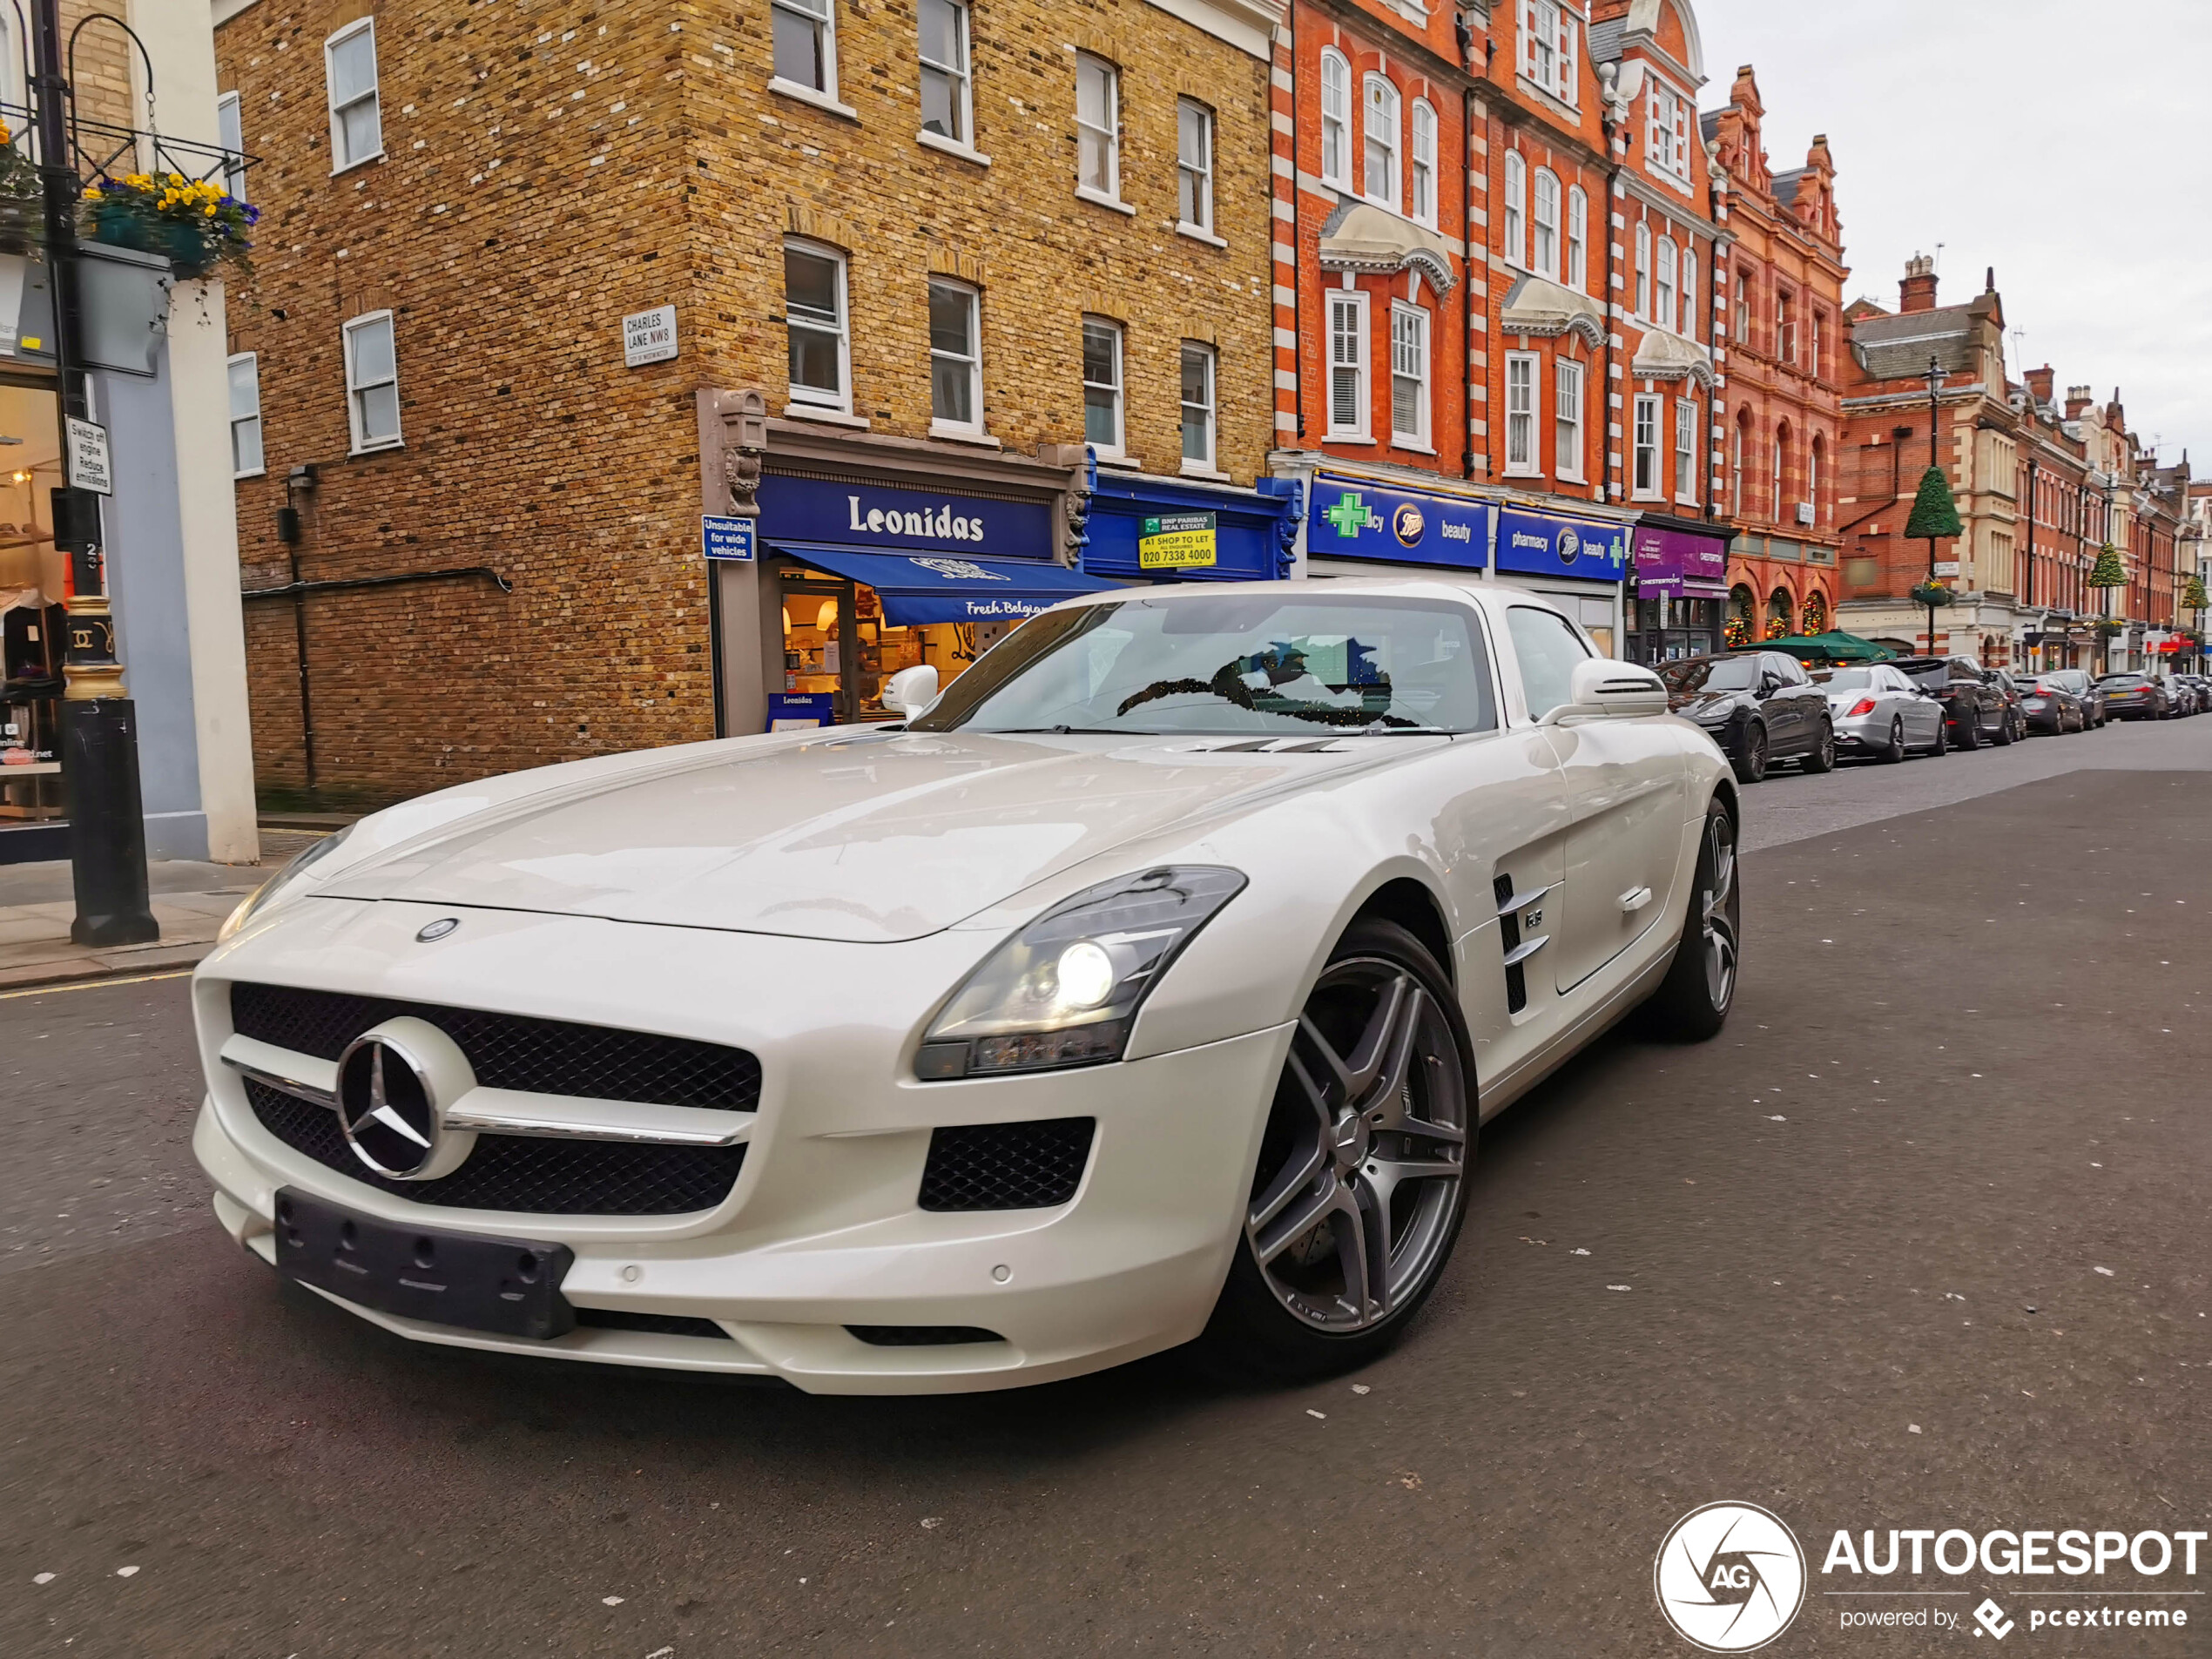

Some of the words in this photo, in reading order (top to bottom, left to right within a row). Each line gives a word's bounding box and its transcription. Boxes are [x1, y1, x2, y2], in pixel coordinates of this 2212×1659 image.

[627, 314, 661, 333] CHARLES
[628, 333, 647, 348] LANE
[650, 327, 669, 345] NW8
[705, 519, 752, 532] Unsuitable
[847, 496, 984, 542] Leonidas
[711, 532, 724, 543] for
[725, 534, 746, 544] wide
[1441, 520, 1471, 543] beauty
[1512, 530, 1548, 552] pharmacy
[1582, 539, 1605, 559] beauty
[711, 545, 747, 556] vehicles
[1143, 551, 1160, 563] 020
[1163, 550, 1185, 562] 7338
[1188, 549, 1211, 560] 4000
[966, 600, 1002, 616] Fresh
[783, 696, 813, 705] Leonidas
